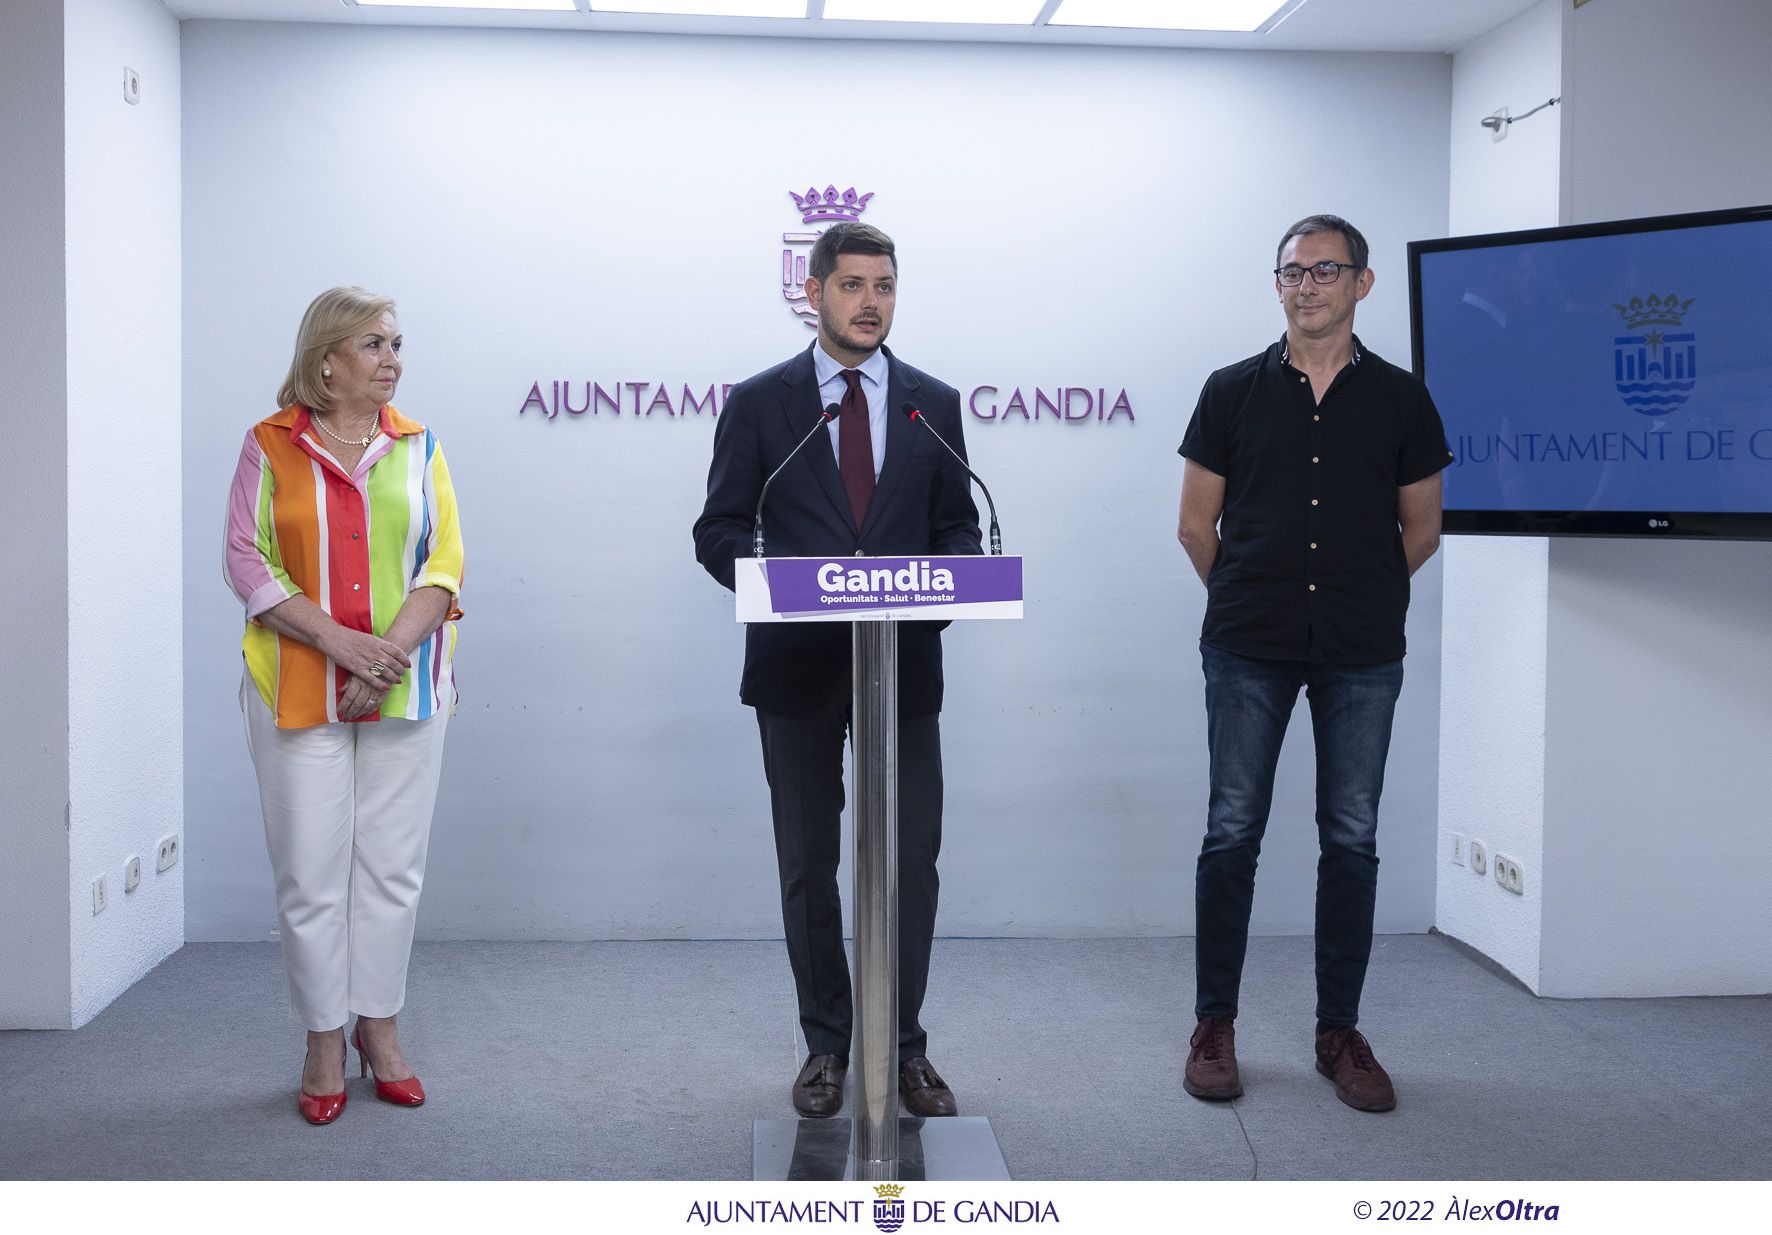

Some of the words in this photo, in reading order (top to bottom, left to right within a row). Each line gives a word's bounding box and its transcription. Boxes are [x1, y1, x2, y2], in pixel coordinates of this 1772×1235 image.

[969, 385, 1136, 421] GANDIA
[1449, 431, 1673, 467] JUNTAMENT
[1687, 430, 1735, 461] DE
[816, 561, 955, 592] Gandia
[820, 594, 879, 605] Oportunitats
[884, 594, 909, 603] Salut
[914, 593, 956, 602] Benestar
